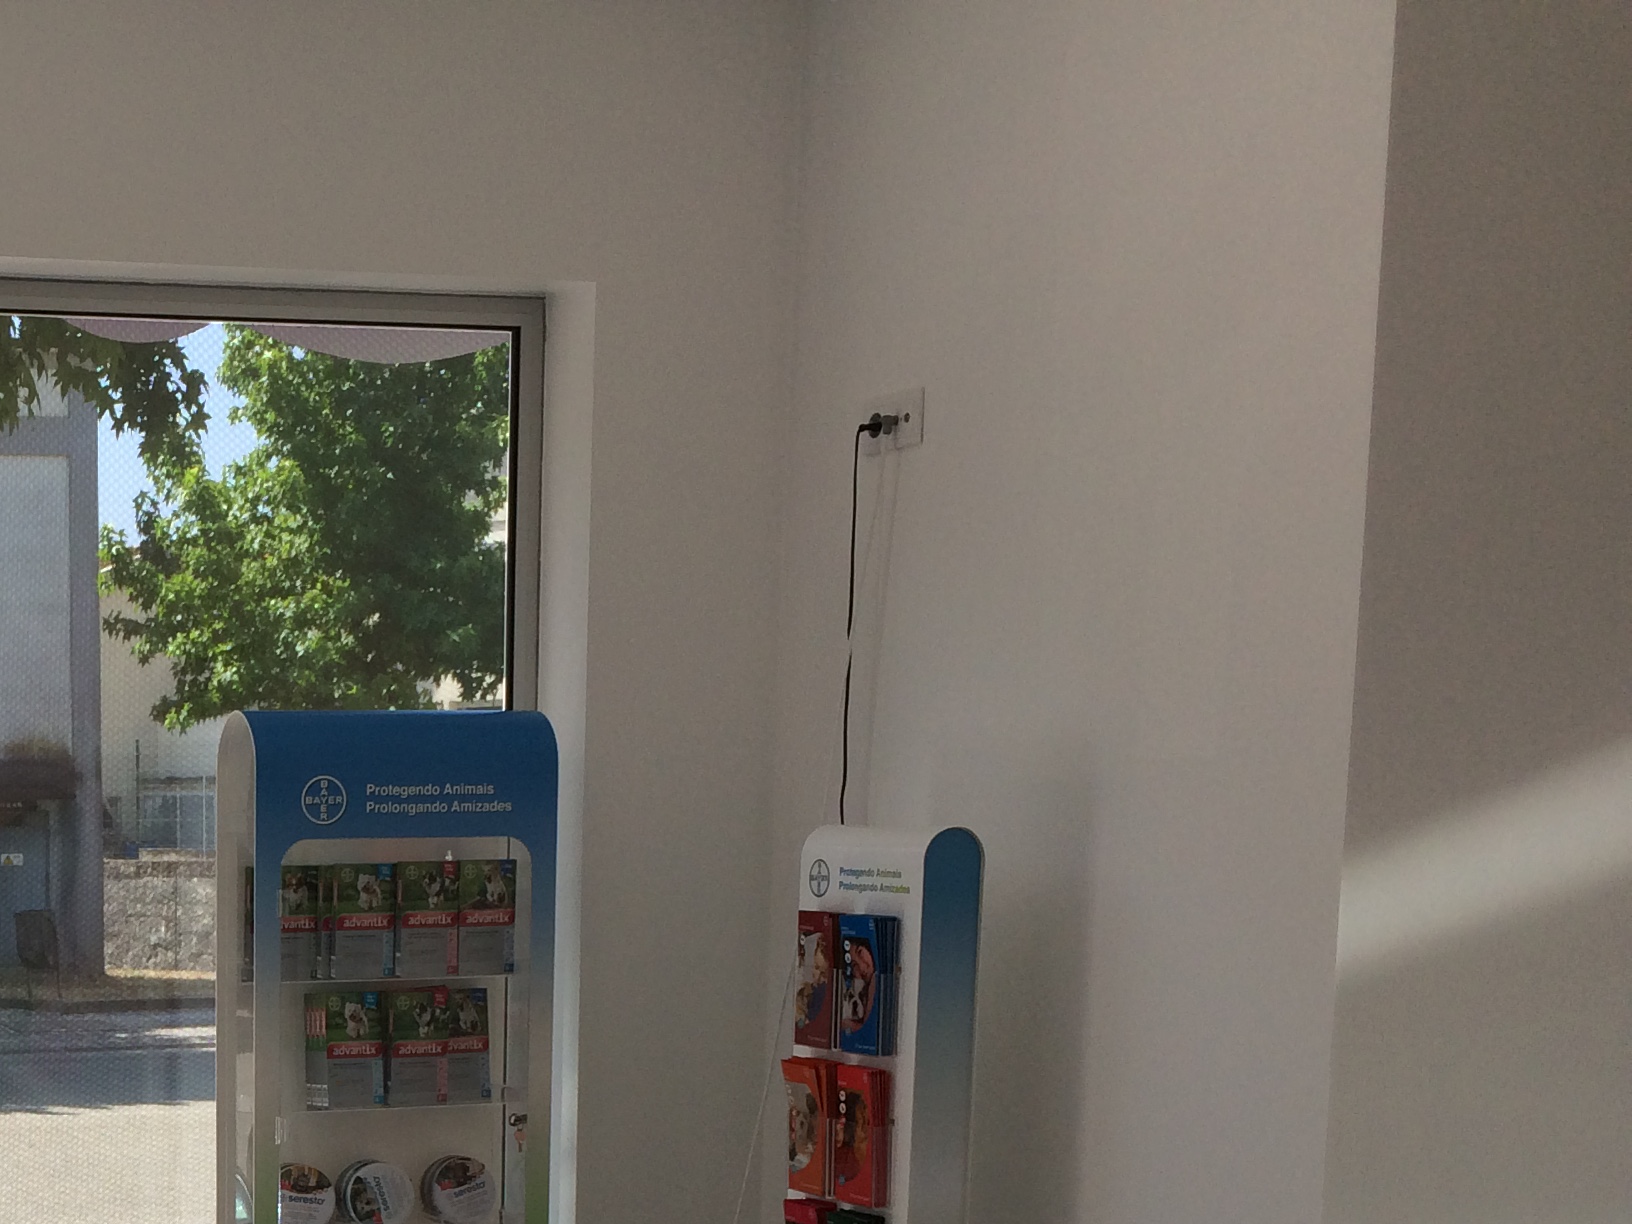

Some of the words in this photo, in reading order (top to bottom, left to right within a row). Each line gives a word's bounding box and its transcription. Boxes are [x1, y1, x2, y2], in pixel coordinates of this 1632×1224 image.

[366, 783, 440, 799] Protegendo
[443, 783, 495, 795] Animais
[305, 796, 343, 804] BAYER
[366, 801, 448, 816] Prolongando
[451, 800, 512, 813] Amizades
[342, 916, 389, 927] advantix
[408, 914, 452, 925] advantix
[465, 912, 510, 924] advantix
[332, 1044, 377, 1056] advantix
[399, 1043, 442, 1055] advantix
